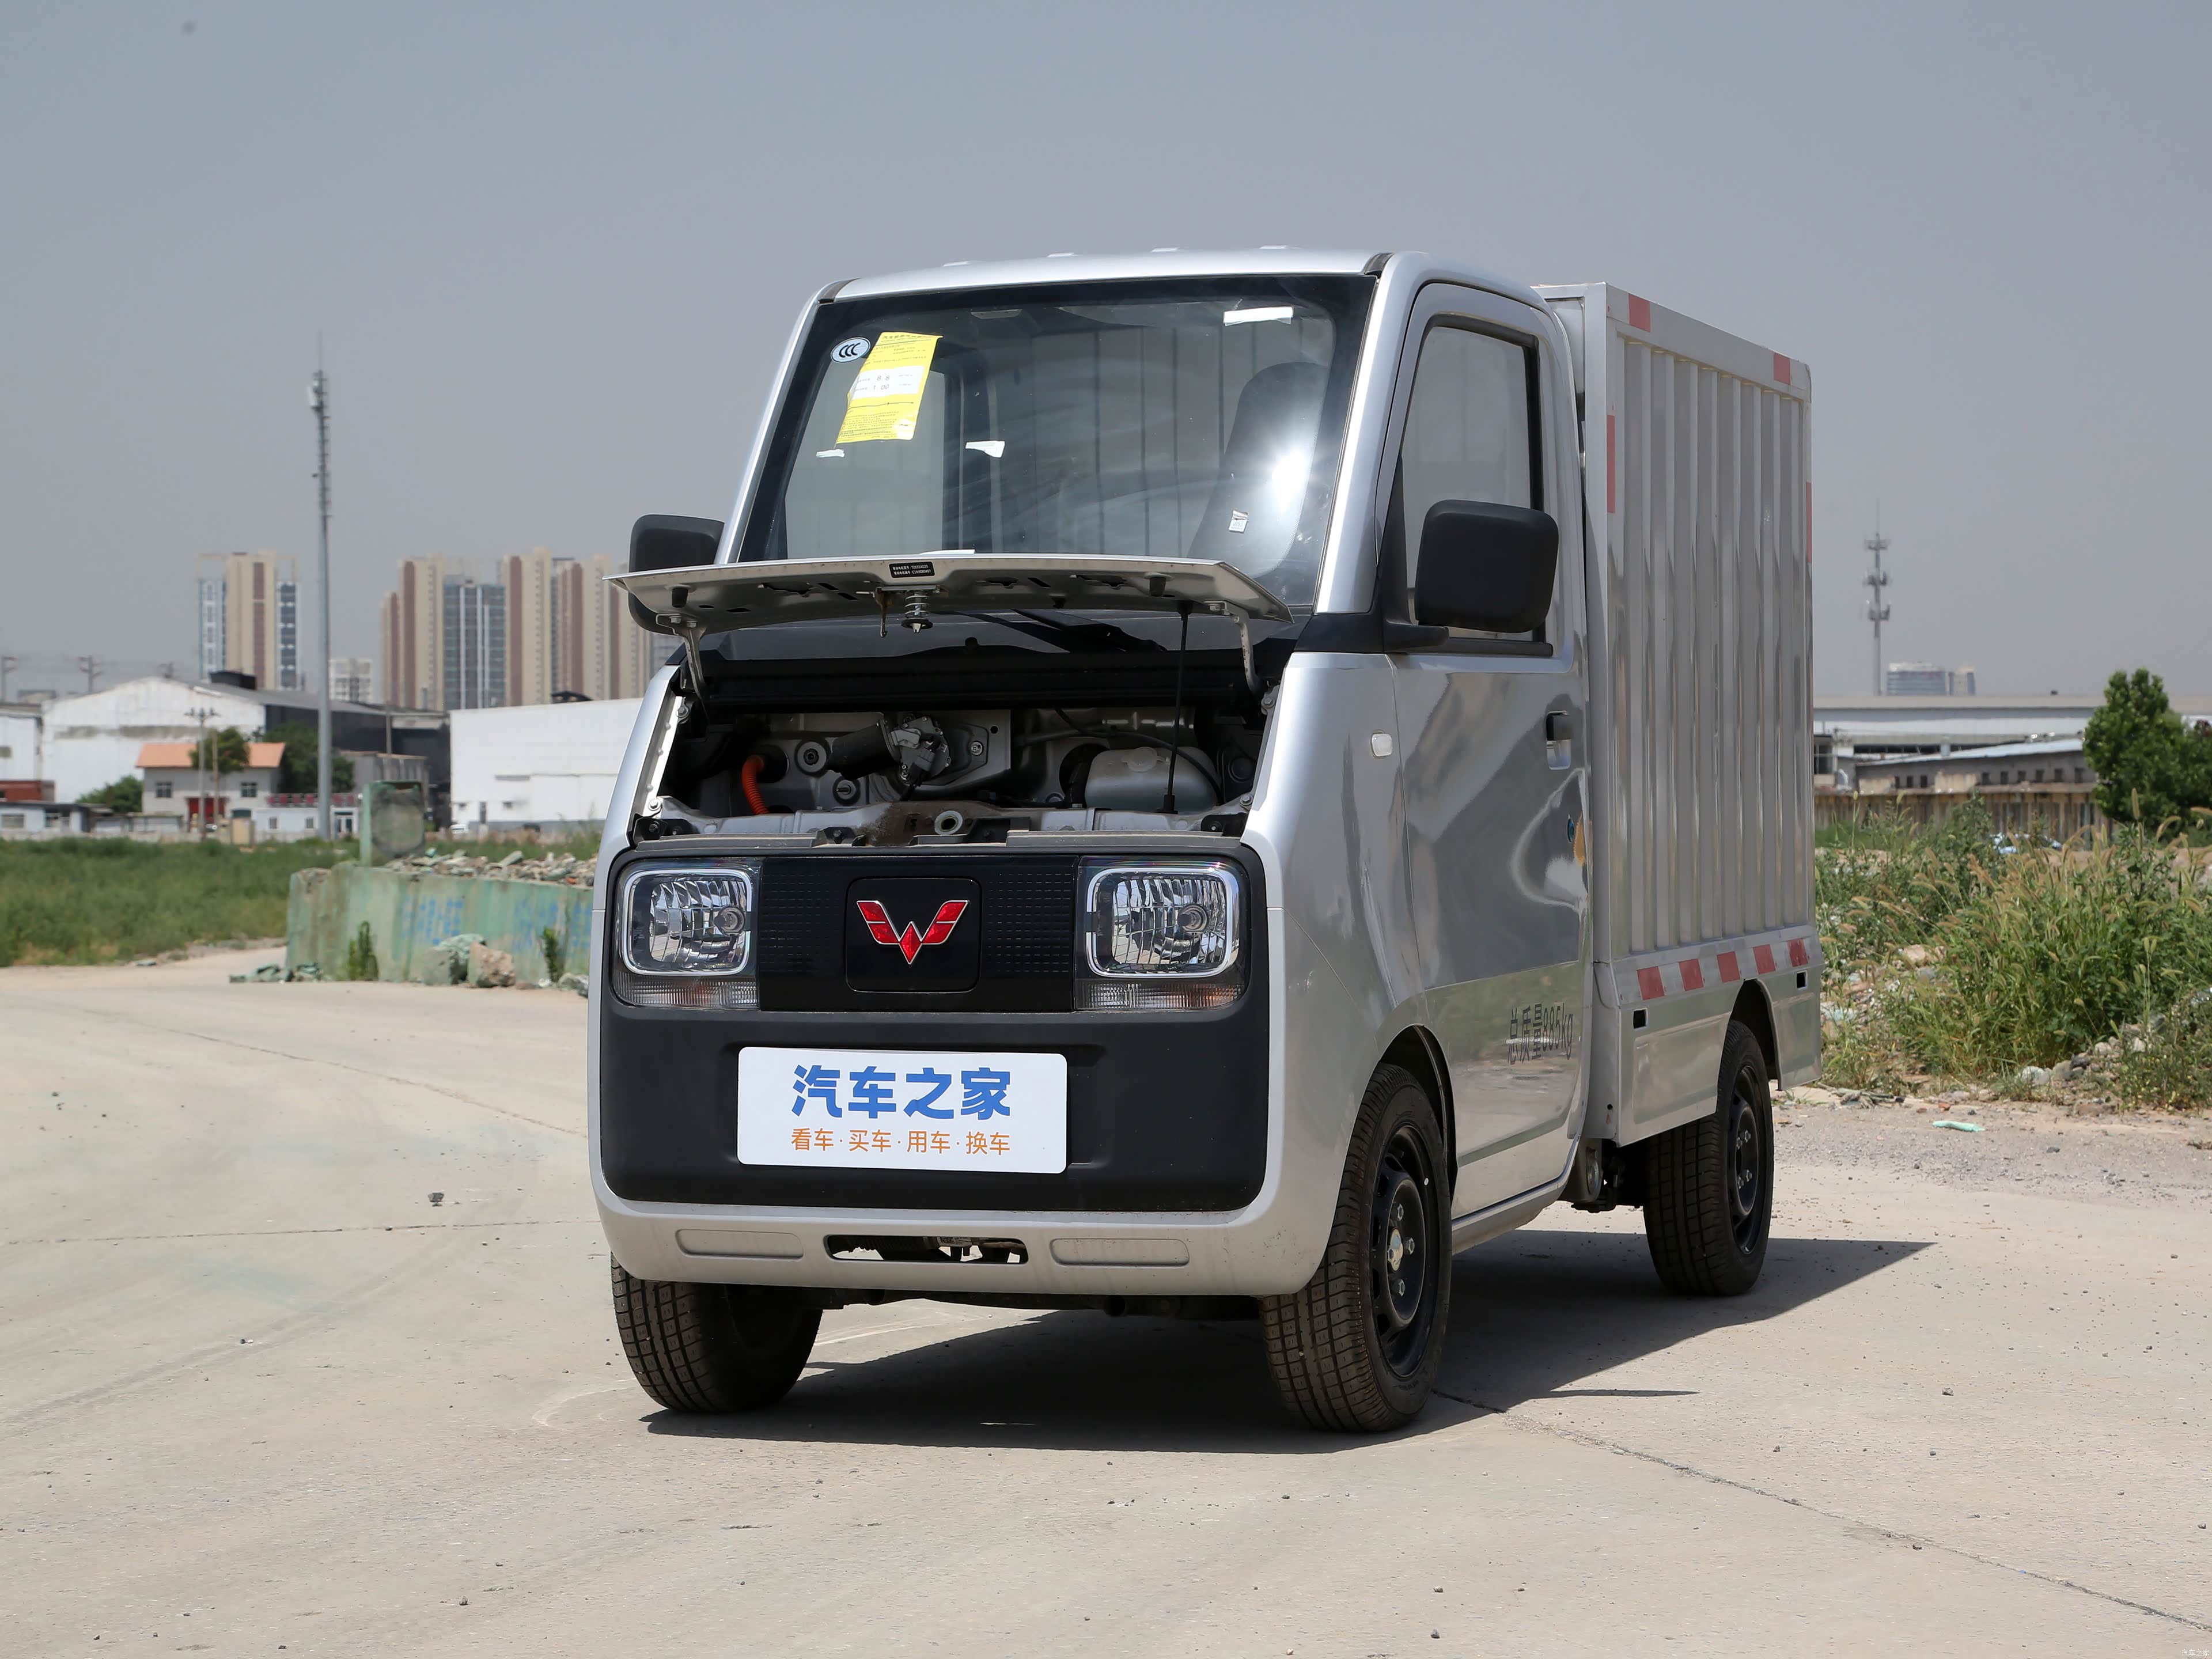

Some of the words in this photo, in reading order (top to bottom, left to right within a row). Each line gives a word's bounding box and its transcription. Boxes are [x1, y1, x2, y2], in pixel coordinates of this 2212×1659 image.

[1508, 1002, 1573, 1065] 总质量885kg
[791, 1064, 1011, 1120] 汽车之家
